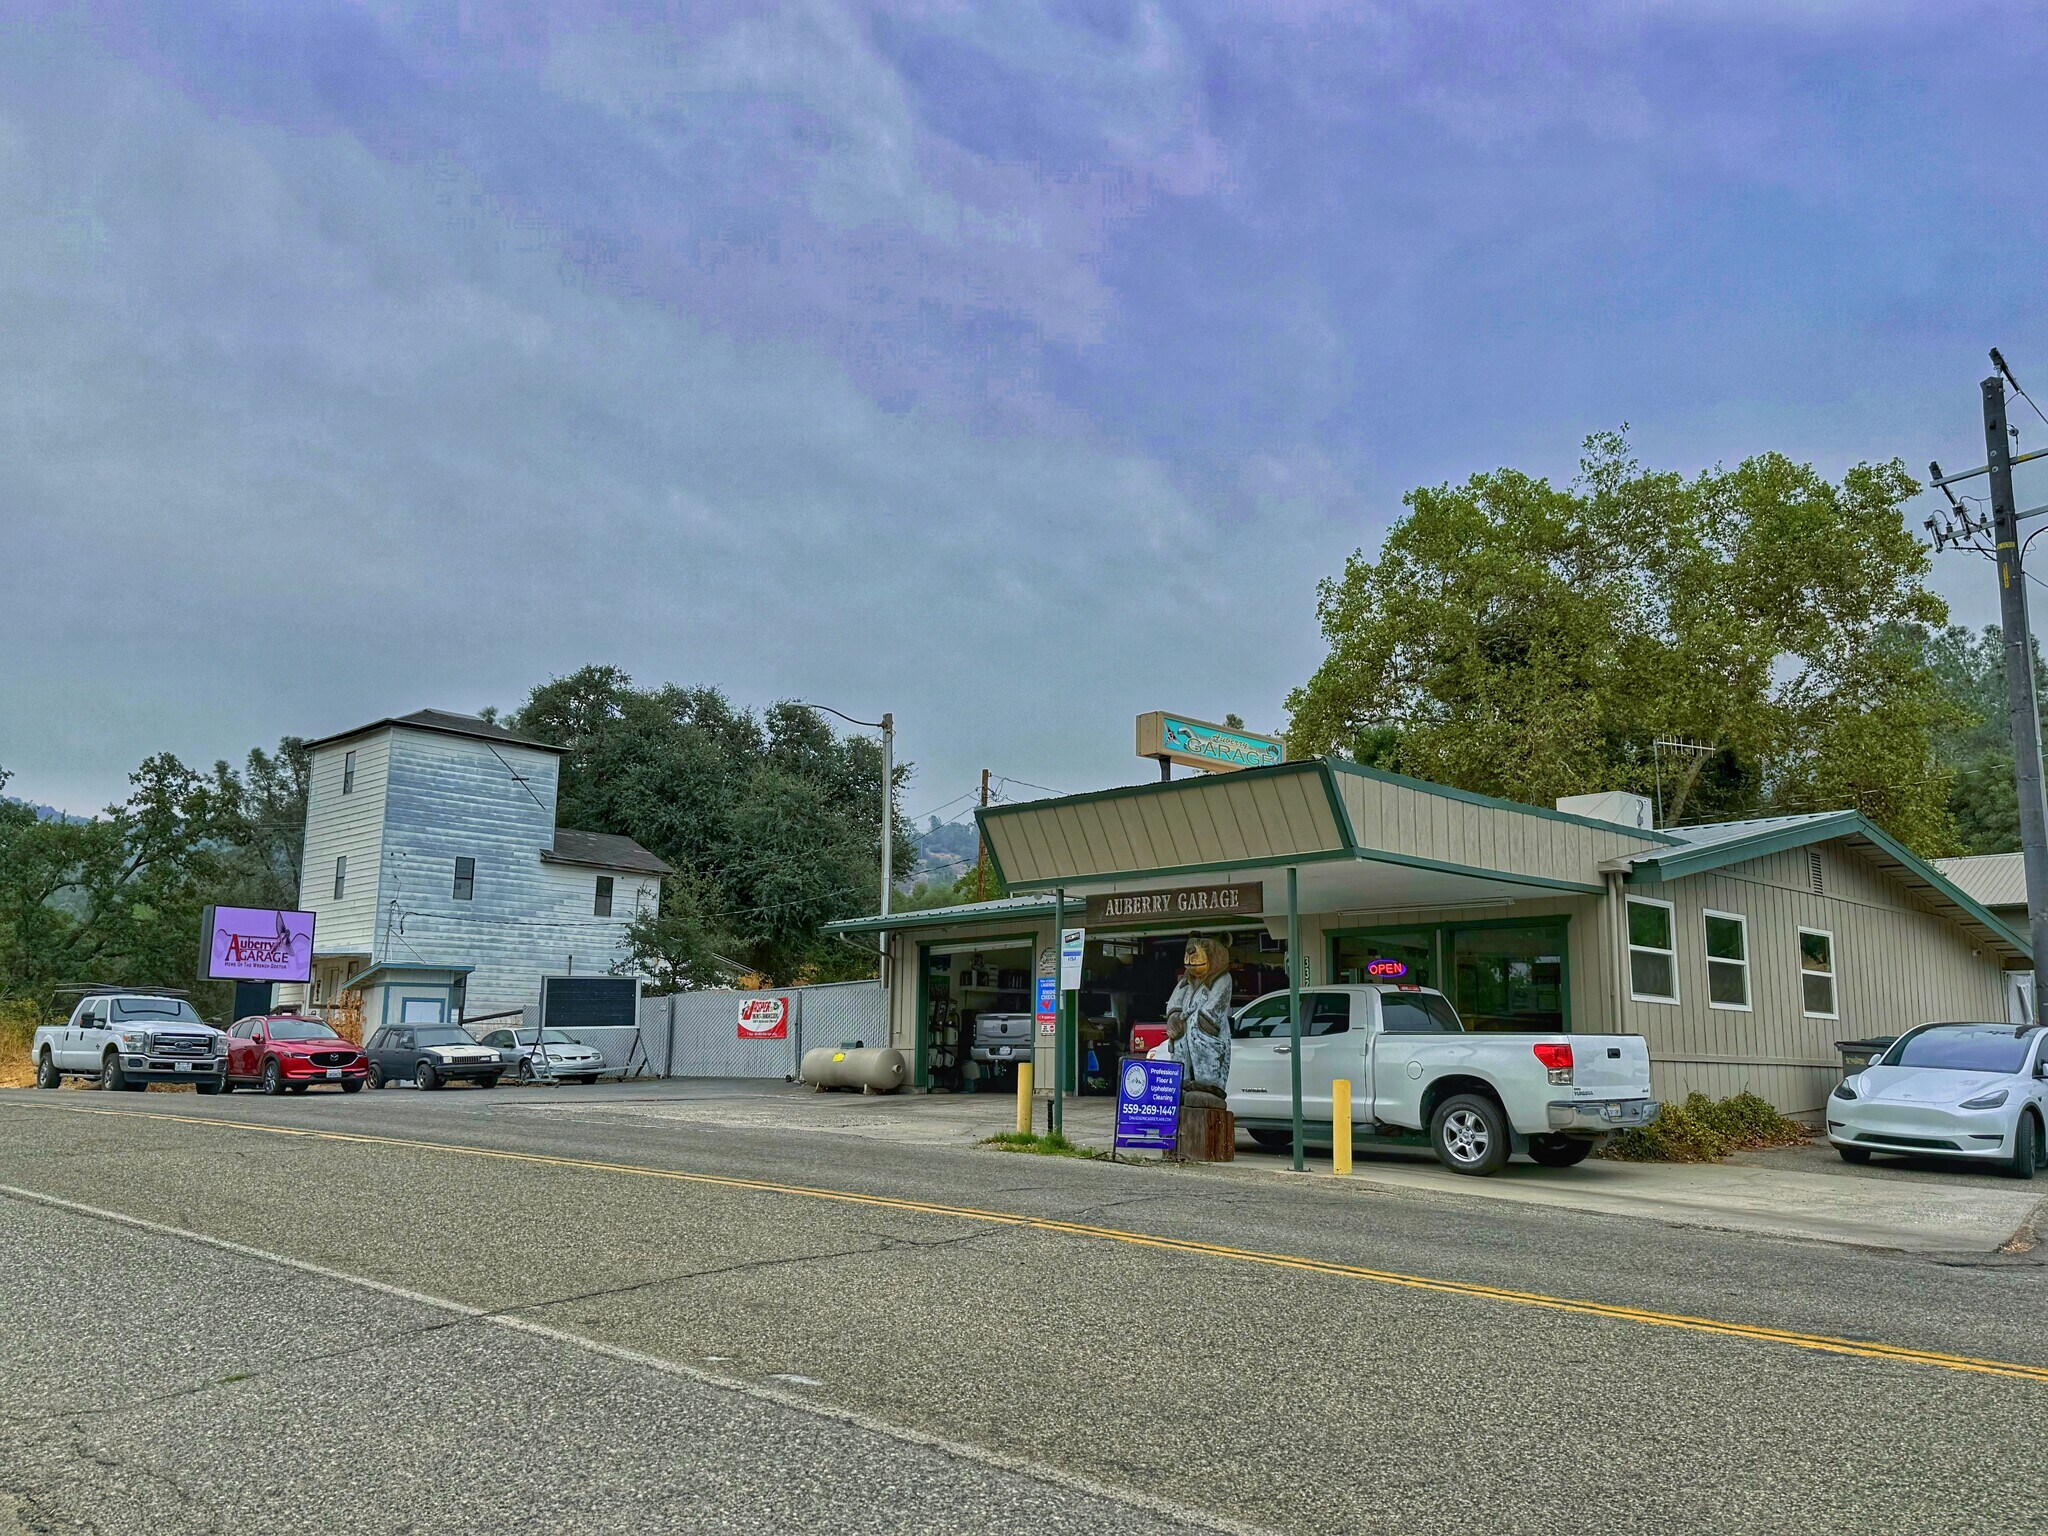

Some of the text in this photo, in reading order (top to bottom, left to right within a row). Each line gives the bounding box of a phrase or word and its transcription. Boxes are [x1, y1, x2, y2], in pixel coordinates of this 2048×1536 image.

[1211, 733, 1248, 749] Auberry
[1187, 738, 1275, 766] GARAGE
[1105, 889, 1239, 916] AUBERRY GARAGE
[225, 934, 274, 961] Auberry
[240, 951, 288, 963] GARAGE
[1369, 962, 1402, 975] OPEN
[1151, 1068, 1179, 1076] Professional
[1151, 1085, 1176, 1094] Upholstery
[1152, 1094, 1173, 1102] Cleaning
[1122, 1103, 1177, 1116] 559-269-1447
